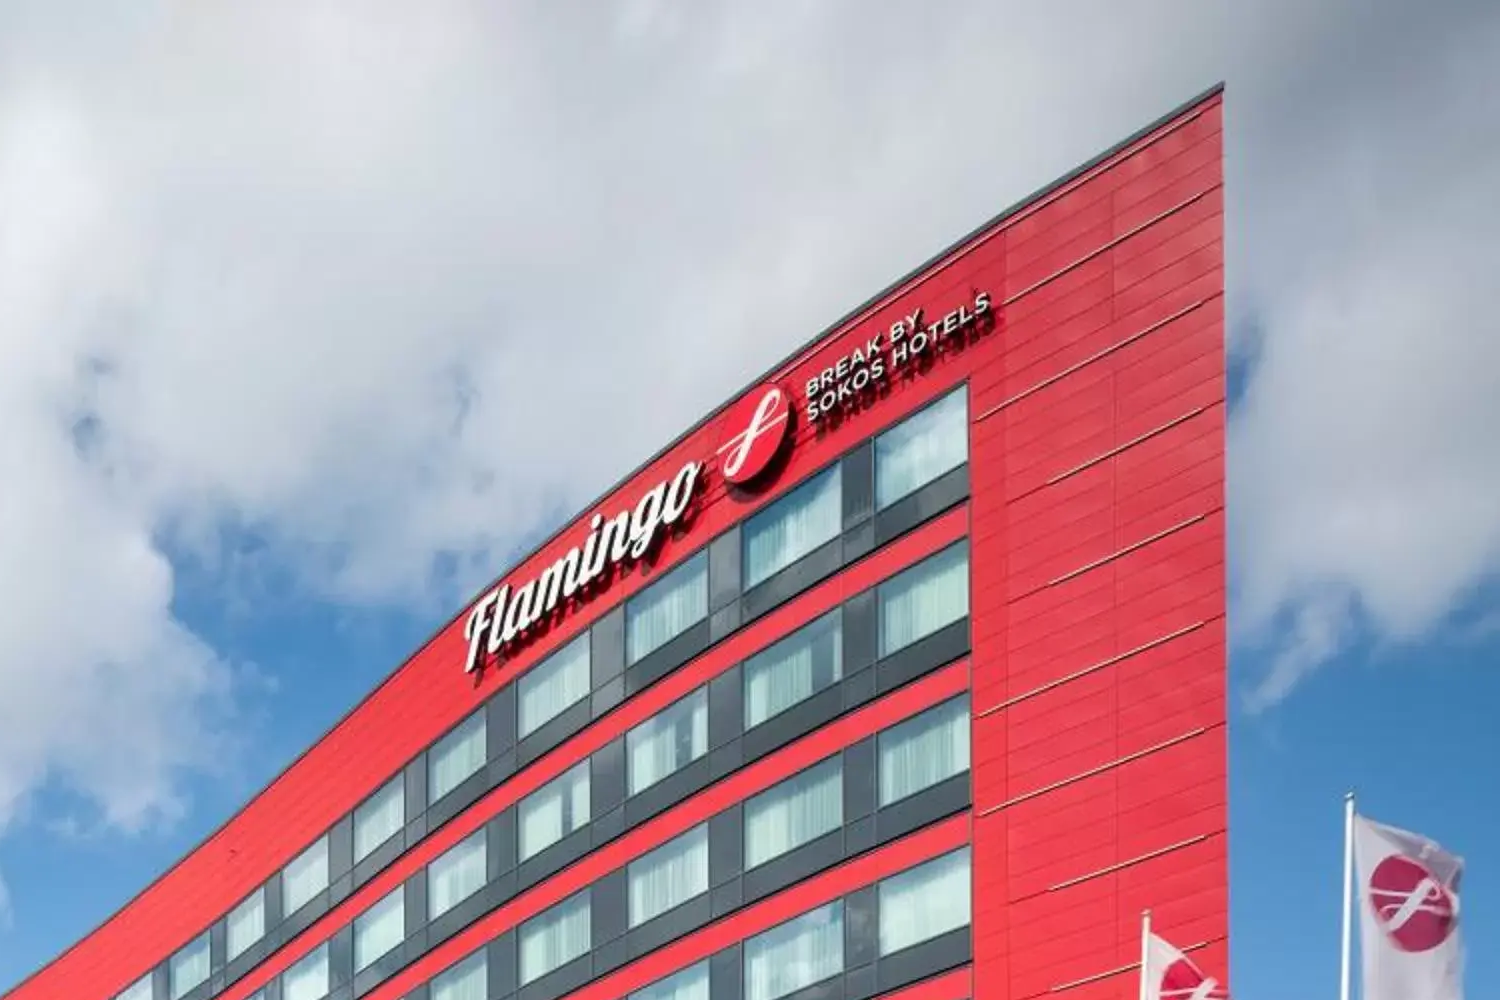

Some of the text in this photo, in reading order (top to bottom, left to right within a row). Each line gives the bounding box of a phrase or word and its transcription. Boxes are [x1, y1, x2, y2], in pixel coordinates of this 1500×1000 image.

[805, 307, 922, 398] BREAK BY
[806, 292, 989, 422] SOKOS HOTELS
[463, 460, 699, 674] Flamingo
